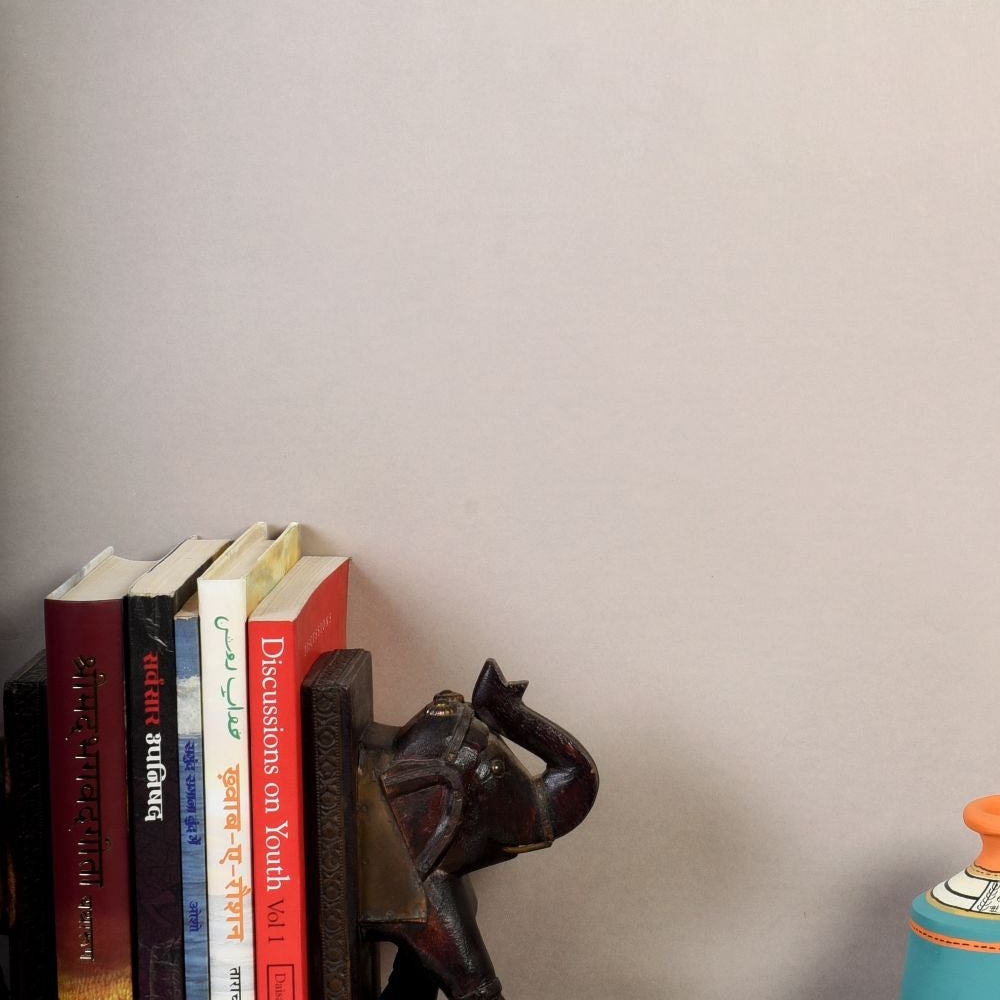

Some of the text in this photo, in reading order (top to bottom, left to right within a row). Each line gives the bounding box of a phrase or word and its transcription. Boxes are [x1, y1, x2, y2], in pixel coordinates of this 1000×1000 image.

[262, 636, 285, 775] Discussions
[144, 653, 167, 822] सर्वसार उपनिषद
[264, 782, 280, 814] on
[266, 820, 291, 892] Youth
[187, 900, 202, 932] ओशो
[267, 899, 286, 928] Vol
